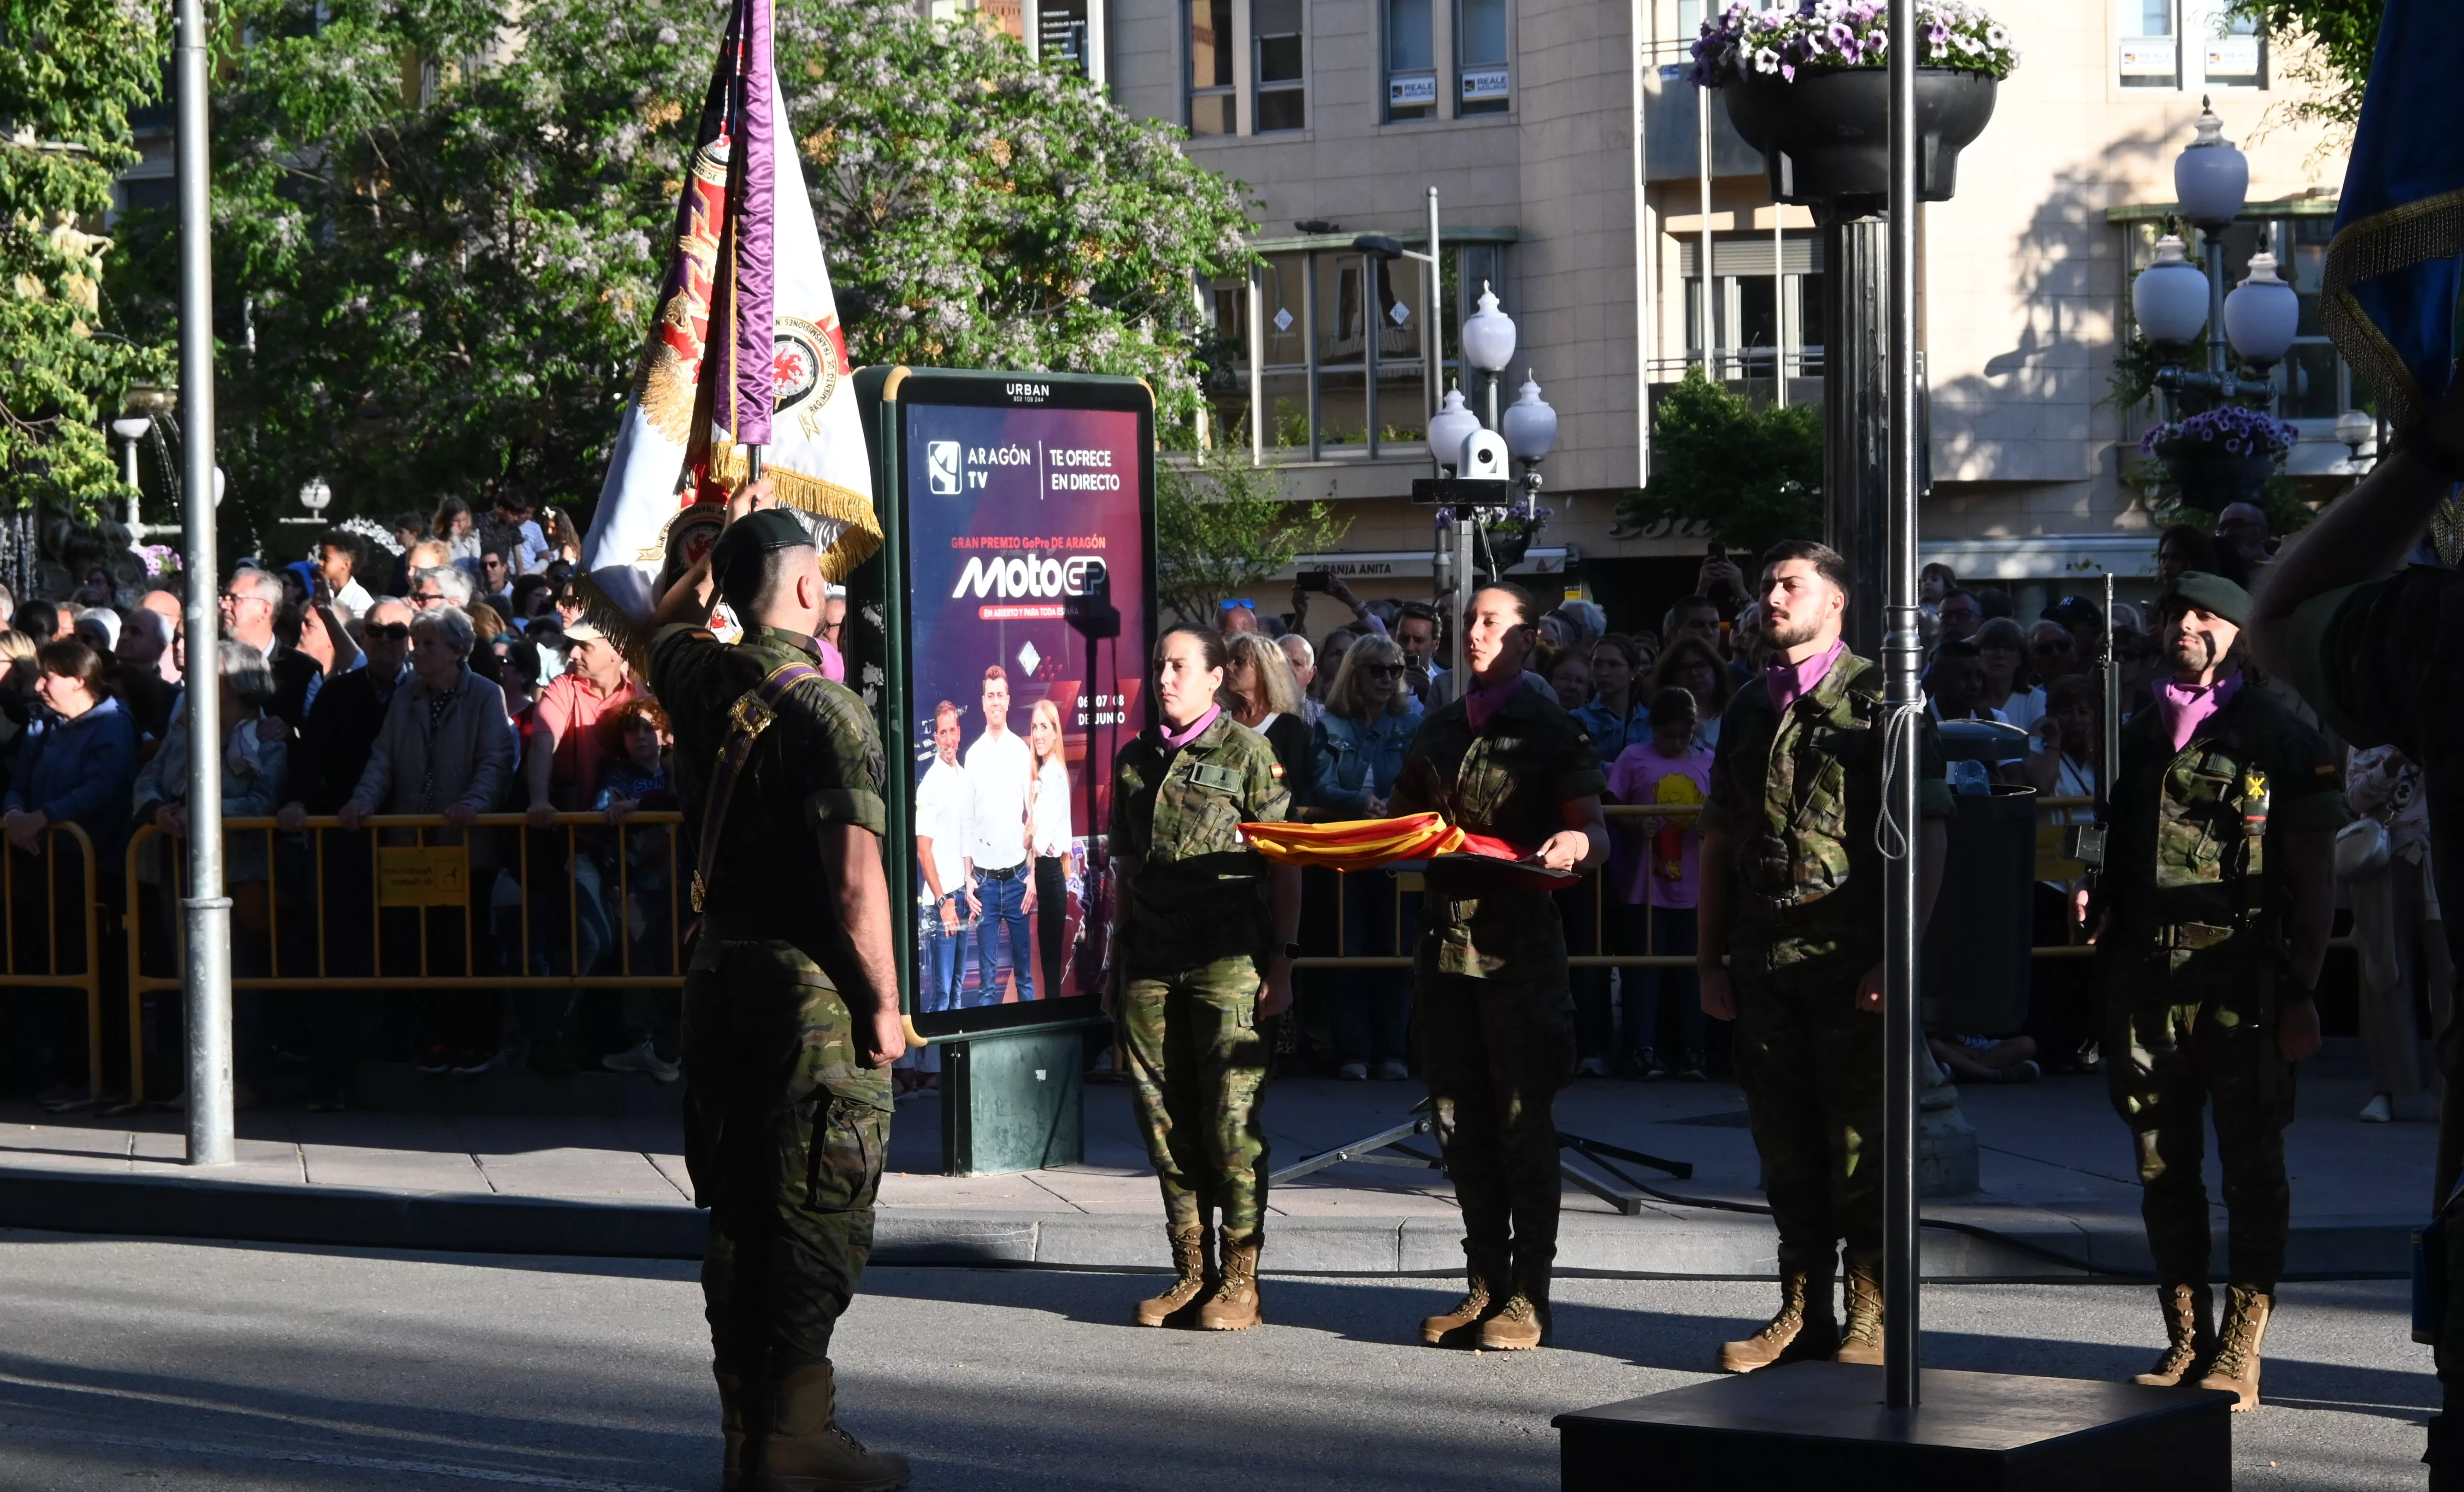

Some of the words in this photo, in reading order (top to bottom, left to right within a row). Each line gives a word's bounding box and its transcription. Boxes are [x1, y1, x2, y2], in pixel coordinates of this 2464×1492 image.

[1404, 82, 1433, 91] REALE
[1477, 76, 1506, 85] REALE
[785, 318, 831, 356] TRANSMISIONES
[828, 360, 834, 369] DE
[809, 374, 835, 413] REGIMIENTO
[1007, 383, 1049, 396] URBAN
[968, 444, 1031, 465] ARAGÓN
[1050, 449, 1063, 466] TE
[1066, 449, 1112, 467] OFRECE
[968, 471, 988, 489] TV
[1052, 474, 1068, 490] EN
[1071, 474, 1120, 491] DIRECTO
[951, 537, 979, 548] GRAN
[981, 537, 1020, 548] PREMIO
[1022, 537, 1049, 548] GoPro
[1052, 537, 1064, 548] DE
[1066, 533, 1106, 548] ARAGÓN
[1315, 564, 1356, 575] GRANJA
[1359, 563, 1391, 575] ANITA
[984, 608, 993, 618] EN
[993, 607, 1019, 618] ABIERTO
[1019, 607, 1023, 617] Y
[1024, 607, 1039, 617] PARA
[1039, 607, 1056, 616] TODA
[1057, 606, 1079, 616] ESPAÑA
[1078, 696, 1088, 708] 06
[1096, 695, 1107, 708] 07
[1113, 694, 1125, 707] 08
[1078, 713, 1090, 725] DE
[1095, 712, 1125, 725] JUNIO
[633, 777, 665, 792] SON
